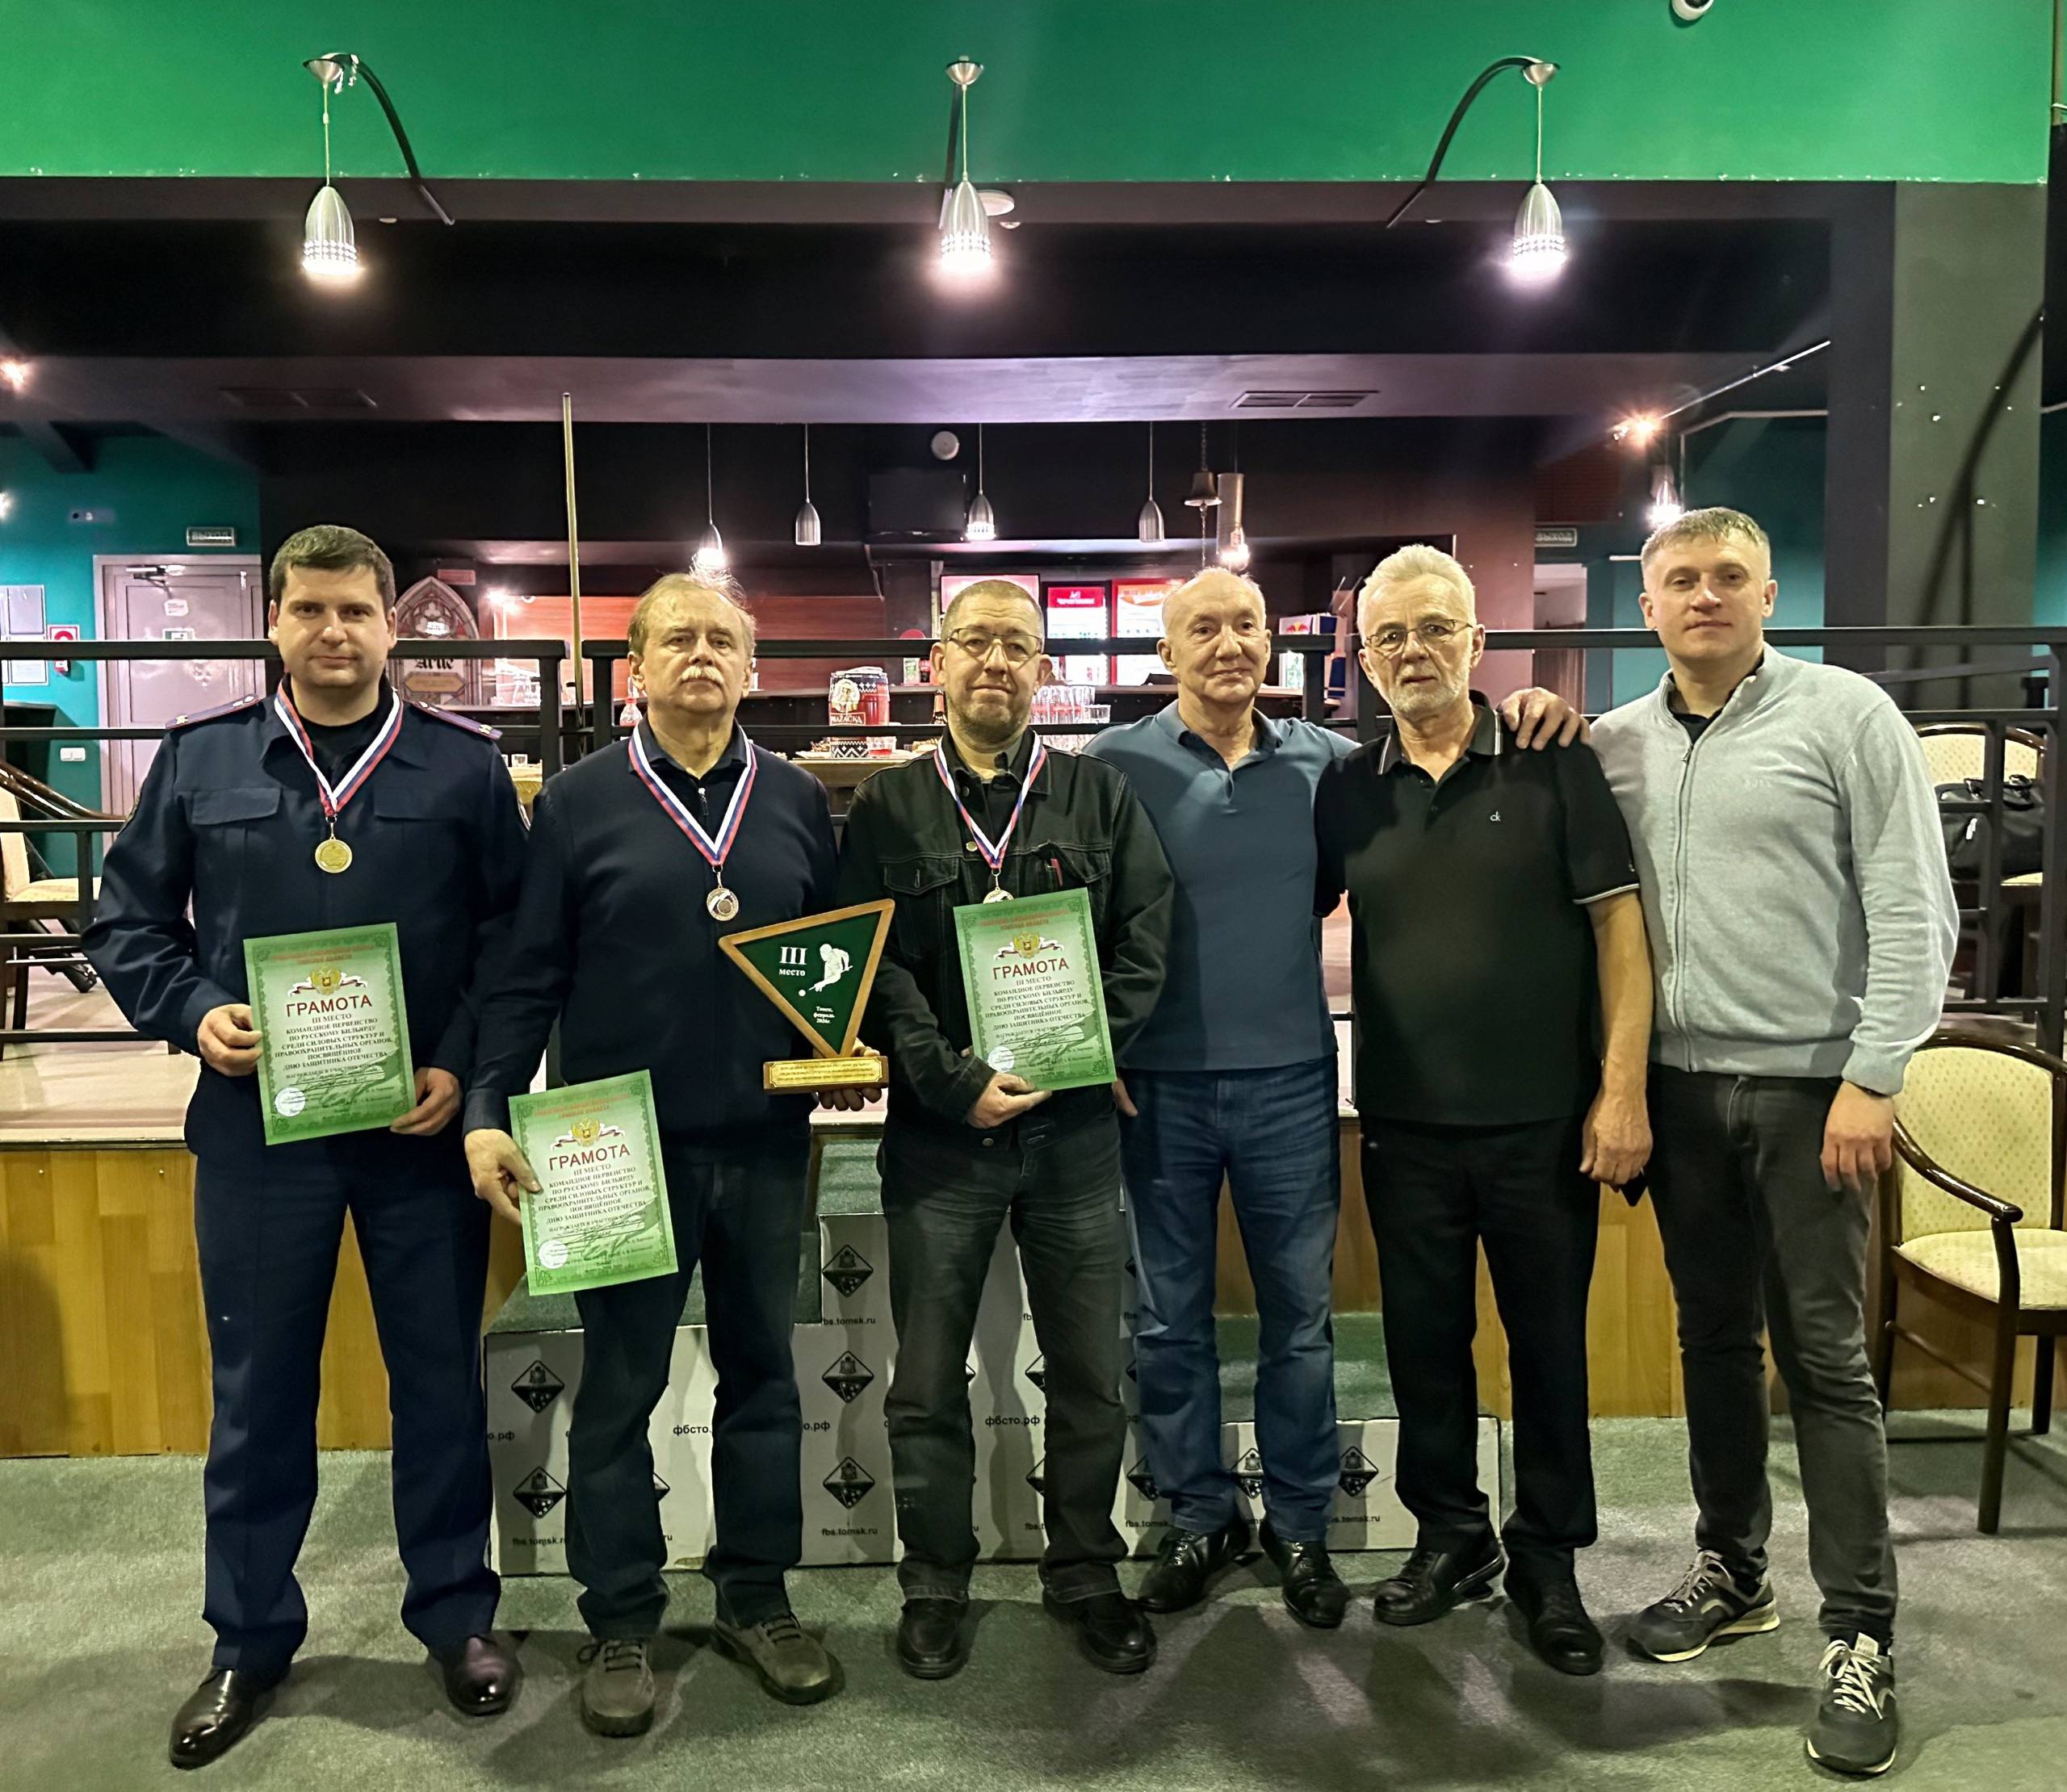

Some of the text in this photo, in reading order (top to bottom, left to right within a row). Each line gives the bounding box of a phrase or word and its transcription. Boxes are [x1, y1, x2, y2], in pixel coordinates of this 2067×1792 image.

[779, 946, 808, 965] III
[778, 969, 806, 977] место
[992, 957, 1068, 980] ГРАМОТА
[1025, 975, 1050, 984] МЕСТО
[994, 980, 1074, 996] КОМАНДНОЕ ПЕРВЕНСТВО
[1007, 991, 1040, 1001] РУССКОМУ
[1042, 986, 1072, 996] БИЛЬЯРДУ
[286, 994, 371, 1016] ГРАМОТА
[1012, 999, 1042, 1007] СИЛОВЫХ
[1044, 993, 1077, 1003] СТРУКТУР
[323, 1013, 351, 1022] МЕСТО
[985, 1003, 1058, 1018] ПРАВООХРАНИТЕЛЬНЫХ
[286, 1018, 377, 1034] КОМАНДНОЕ ПЕРВЕНСТВО
[1009, 1017, 1047, 1028] ЗАЩИТНИКА
[1049, 1011, 1085, 1022] ОТЕЧЕСТВА
[282, 1041, 304, 1049] СРЕДИ
[306, 1037, 341, 1046] СИЛОВЫХ
[342, 1032, 379, 1041] СТРУКТУР
[301, 1029, 338, 1040] РУССКОМУ
[341, 1025, 375, 1034] БИЛЬЯРДУ
[275, 1041, 358, 1057] ПРАВООХРАНИТЕЛЬНЫХ
[303, 1057, 346, 1067] ЗАЩИТНИКА
[347, 1051, 388, 1061] ОТЕЧЕСТВА
[548, 1143, 630, 1170] ГРАМОТА
[583, 1163, 610, 1174] МЕСТО
[549, 1166, 635, 1188] КОМАНДНОЕ ПЕРВЕНСТВО
[563, 1181, 598, 1193] РУССКОМУ
[601, 1174, 634, 1185] БИЛЬЯРДУ
[544, 1195, 566, 1204] СРЕДИ
[568, 1187, 601, 1199] СИЛОВЫХ
[603, 1181, 638, 1192] СТРУКТУР
[539, 1191, 618, 1212] ПРАВООХРАНИТЕЛЬНЫХ
[547, 1216, 563, 1224] ДНЮ
[564, 1208, 606, 1220] ЗАЩИТНИКА
[607, 1200, 646, 1212] ОТЕЧЕСТВА
[985, 1415, 1040, 1427] фбсто.рф
[487, 1430, 514, 1442] о.рф
[822, 1528, 878, 1536] fbs.tomsk.ru
